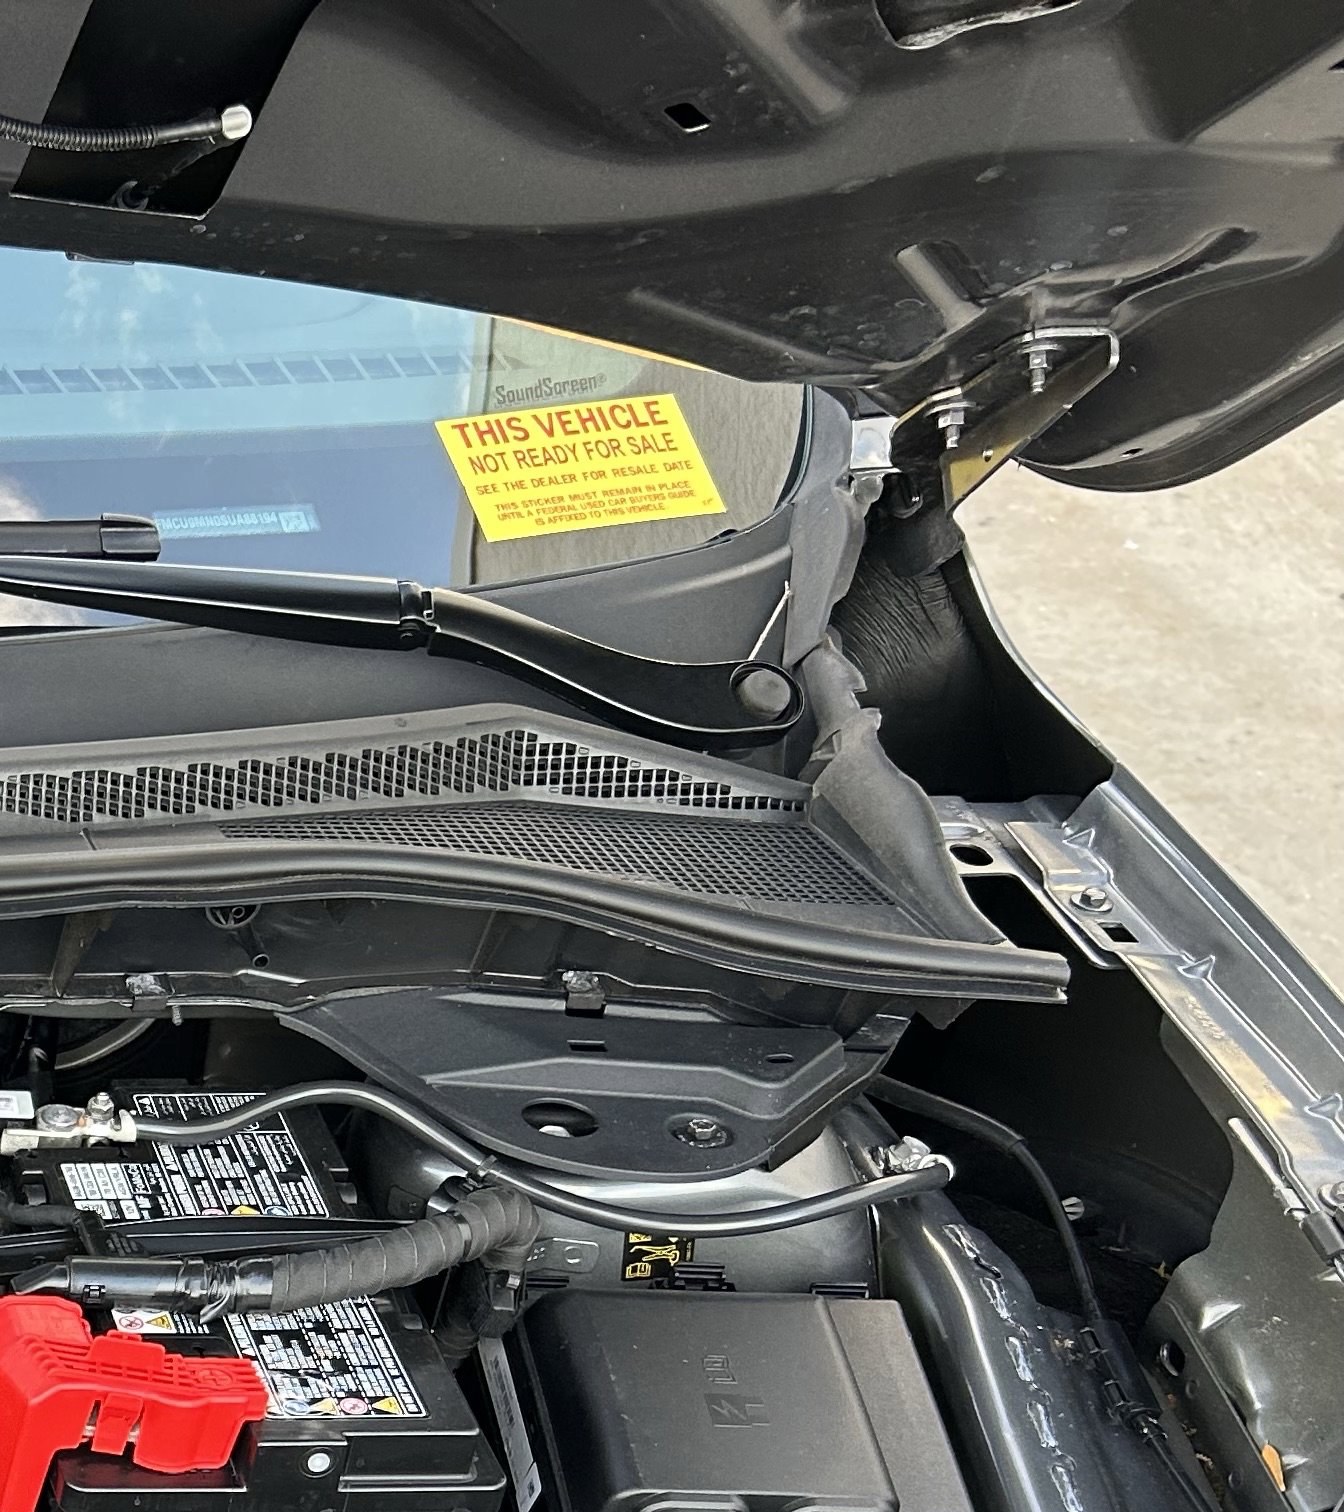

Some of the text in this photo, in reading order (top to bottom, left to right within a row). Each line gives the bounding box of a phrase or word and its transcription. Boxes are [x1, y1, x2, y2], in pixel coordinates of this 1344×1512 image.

[452, 400, 668, 448] THIS VEHICLE
[468, 432, 679, 475] NOT READY FOR SALE
[476, 460, 693, 496] SEE THE DEALER FOR RESALE DATE
[494, 502, 518, 512] THIS
[520, 496, 564, 509] STICKER
[568, 491, 597, 502] MUST
[602, 487, 642, 498] REMAIN
[658, 480, 691, 491] PLACE
[497, 511, 524, 522] UNTIL
[536, 504, 576, 516] FEDERAL
[580, 500, 605, 510] USED
[608, 497, 627, 506] CAR
[630, 492, 666, 504] BUYERS
[668, 489, 696, 500] GUIDE
[535, 518, 543, 526] IS
[544, 512, 586, 524] AFFIXED
[590, 510, 602, 519] TO
[604, 506, 625, 518] THIS
